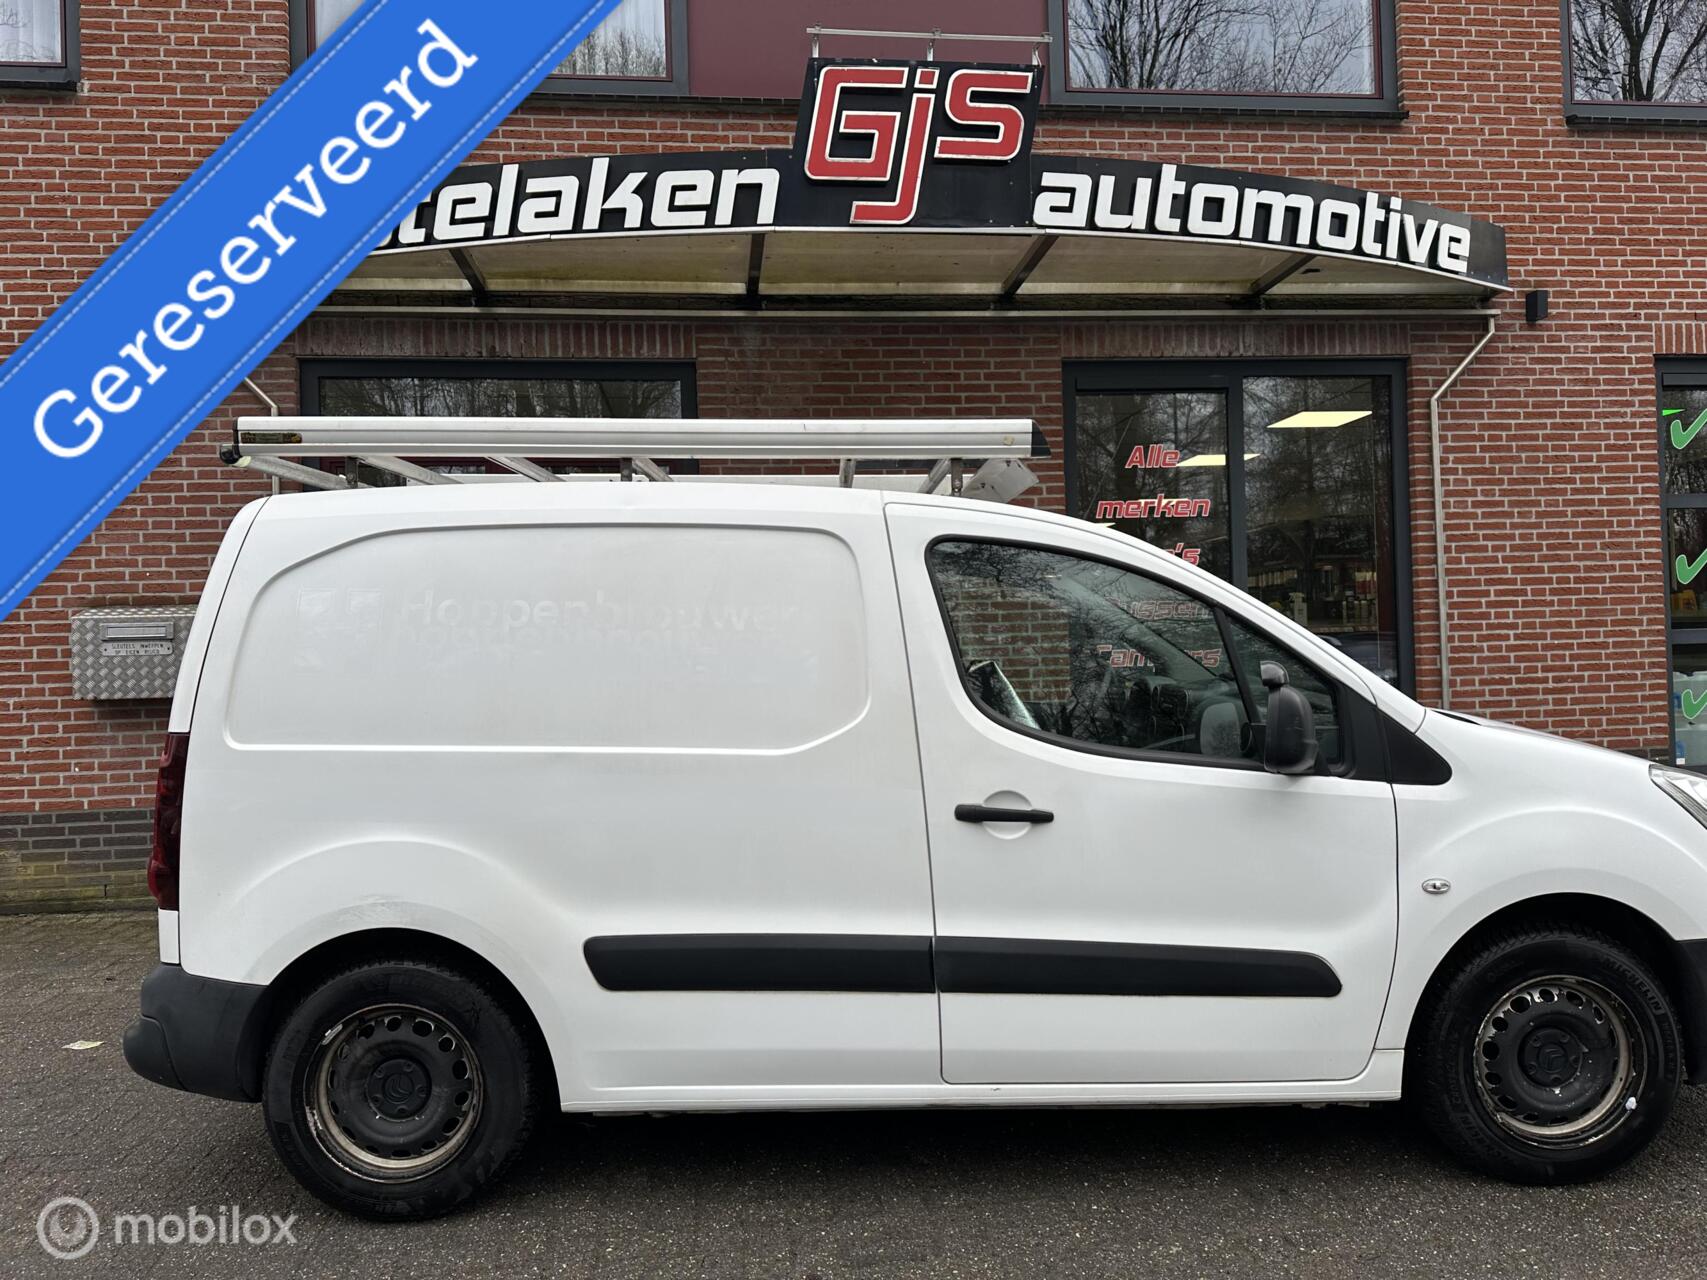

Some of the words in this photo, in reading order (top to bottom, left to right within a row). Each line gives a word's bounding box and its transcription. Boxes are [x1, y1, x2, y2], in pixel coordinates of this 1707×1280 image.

[378, 157, 780, 247] telaken
[1033, 163, 1471, 274] automotive
[1125, 444, 1180, 468] Alle
[1096, 494, 1211, 518] merken
